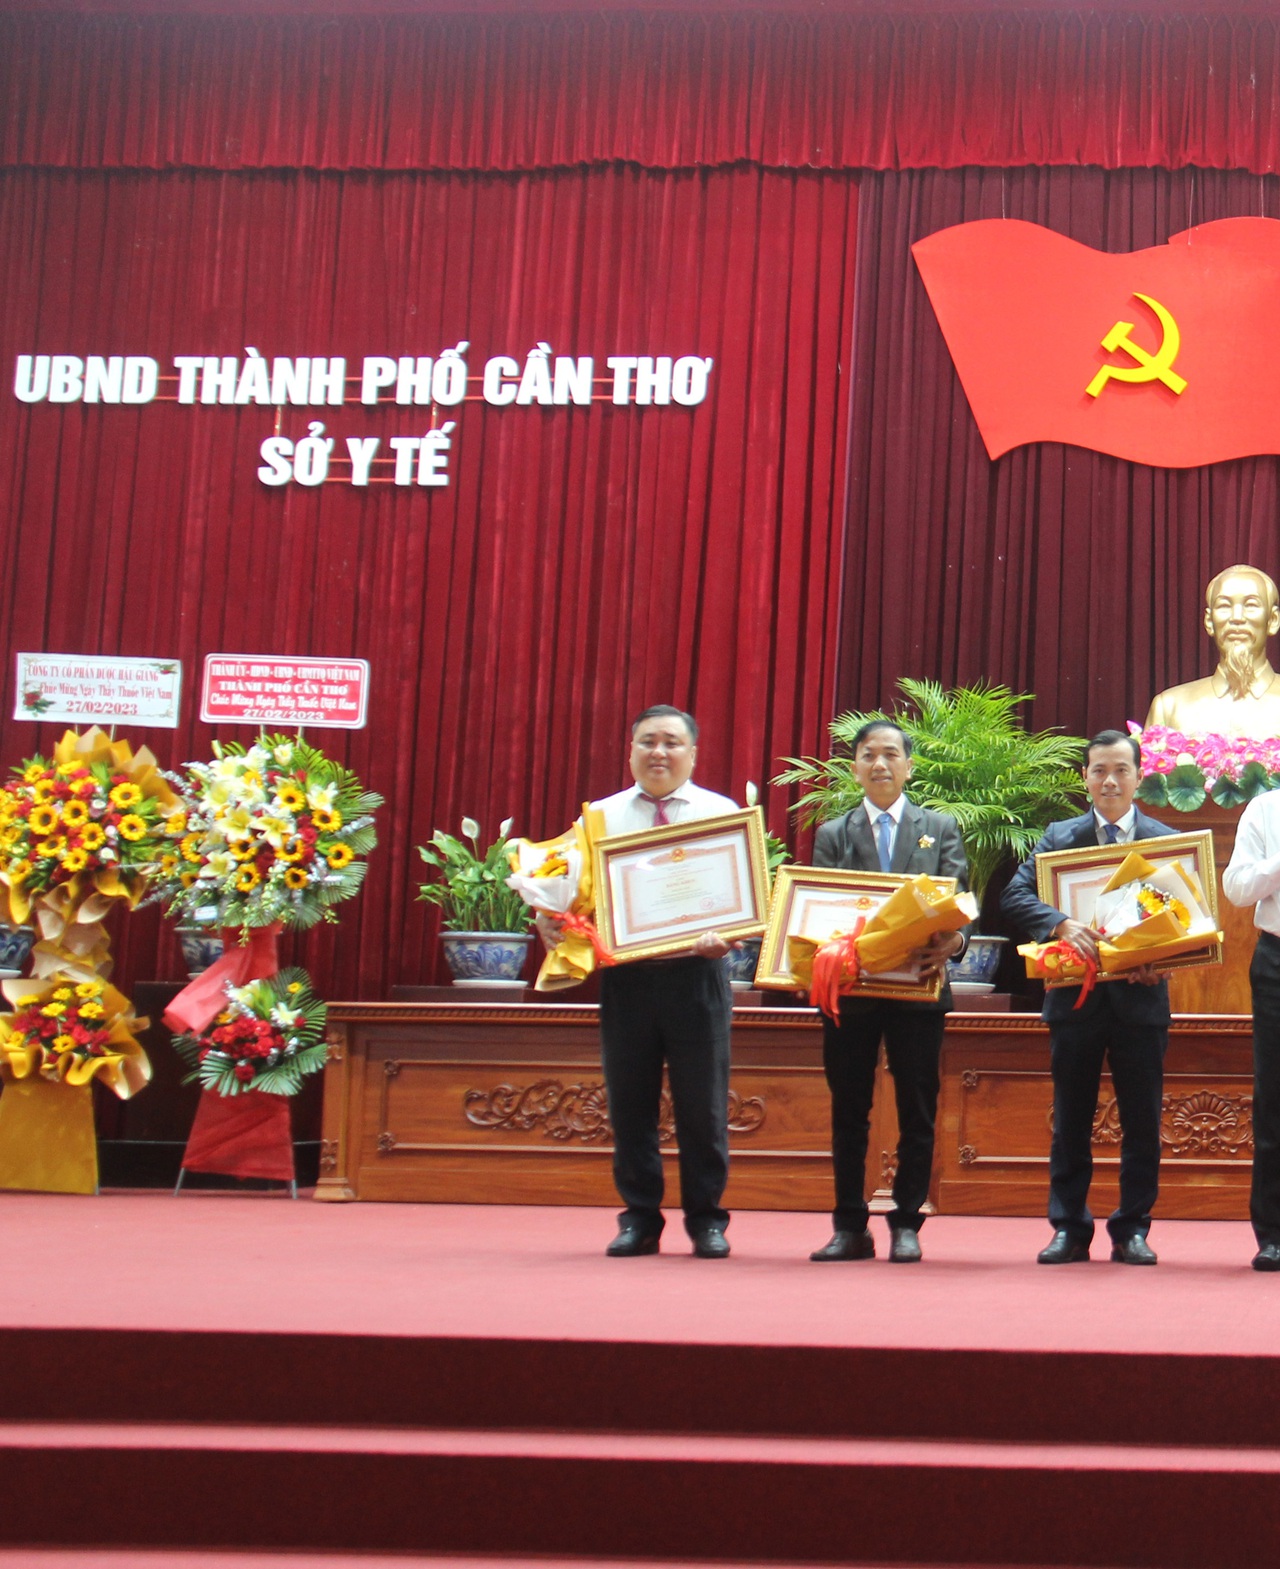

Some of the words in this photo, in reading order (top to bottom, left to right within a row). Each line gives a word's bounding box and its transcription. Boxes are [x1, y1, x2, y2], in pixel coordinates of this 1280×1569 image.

[15, 355, 159, 404] UBND
[174, 347, 347, 405] THÀNH
[361, 342, 469, 406] PHỐ
[483, 342, 593, 405] CẦN
[606, 356, 713, 405] THƠ
[257, 421, 334, 487] SỞ
[346, 437, 380, 486] Y
[390, 421, 456, 486] TẾ
[51, 665, 59, 678] TY
[218, 679, 262, 692] THÀNH
[264, 679, 292, 693] PHỐ
[66, 700, 138, 716] 27/02/2023
[243, 708, 325, 720] 27/02/2023
